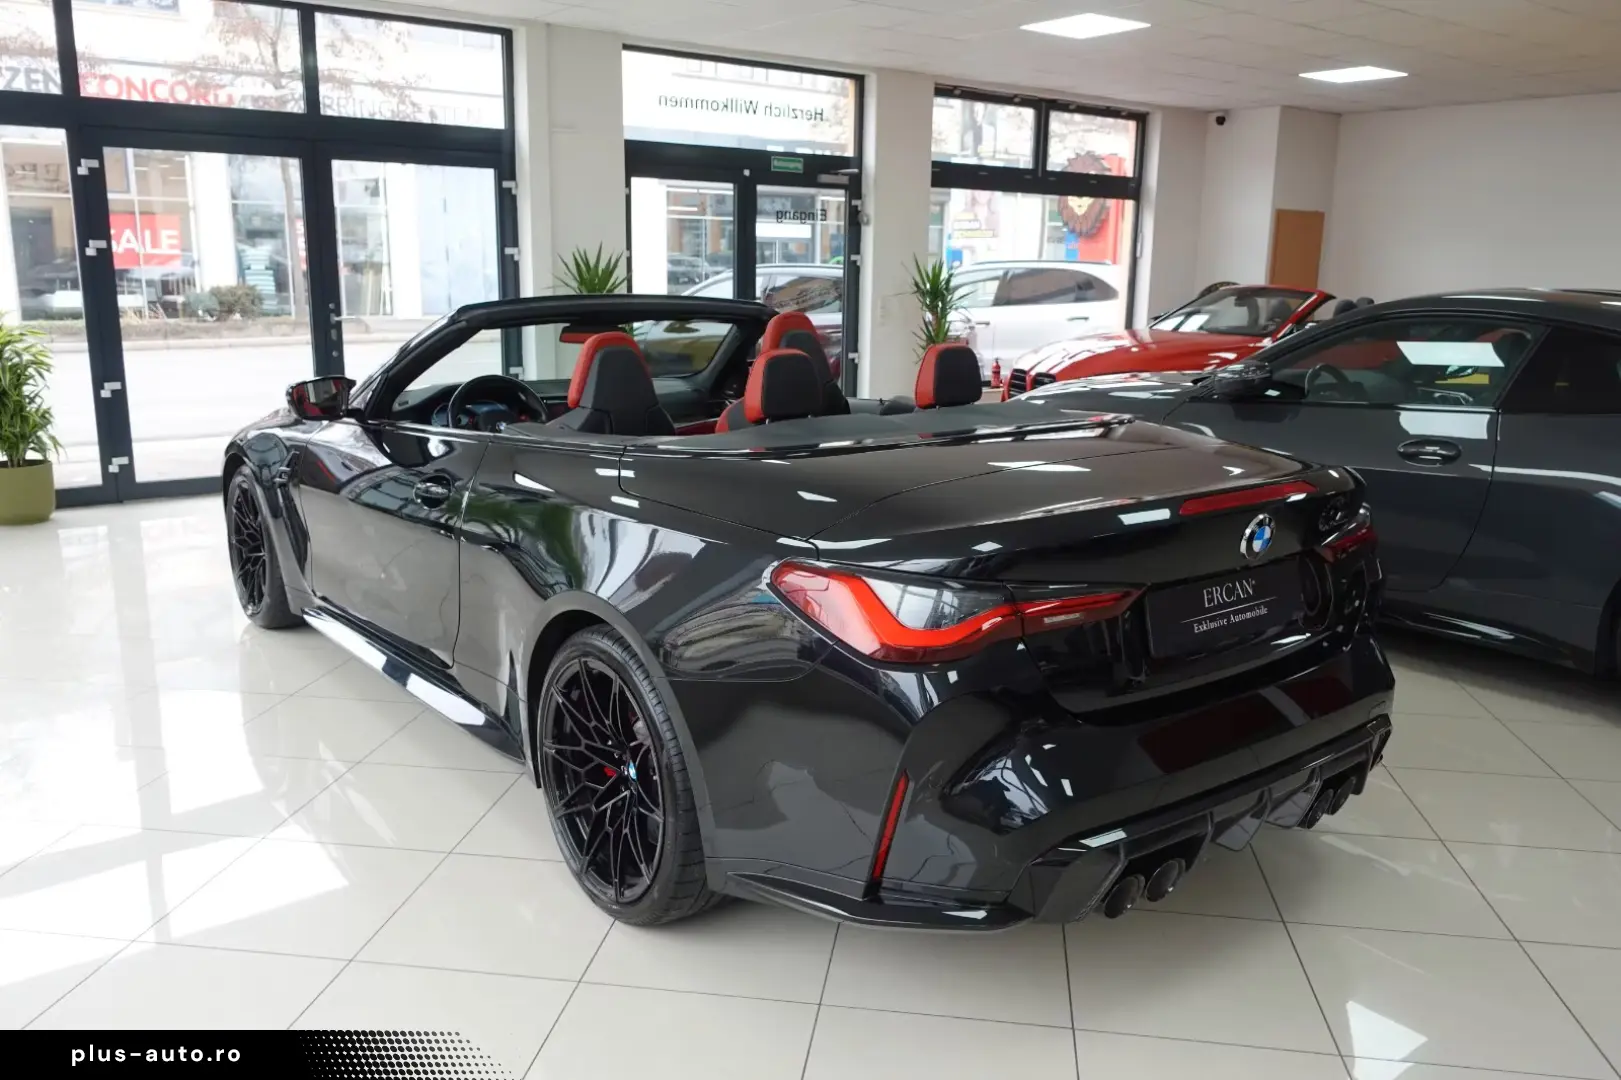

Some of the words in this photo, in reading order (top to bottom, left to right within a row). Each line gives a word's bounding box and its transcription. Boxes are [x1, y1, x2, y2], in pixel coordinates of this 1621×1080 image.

[1203, 578, 1253, 608] ERCAN
[1193, 617, 1228, 633] Exklusive
[1229, 605, 1268, 623] Automobile
